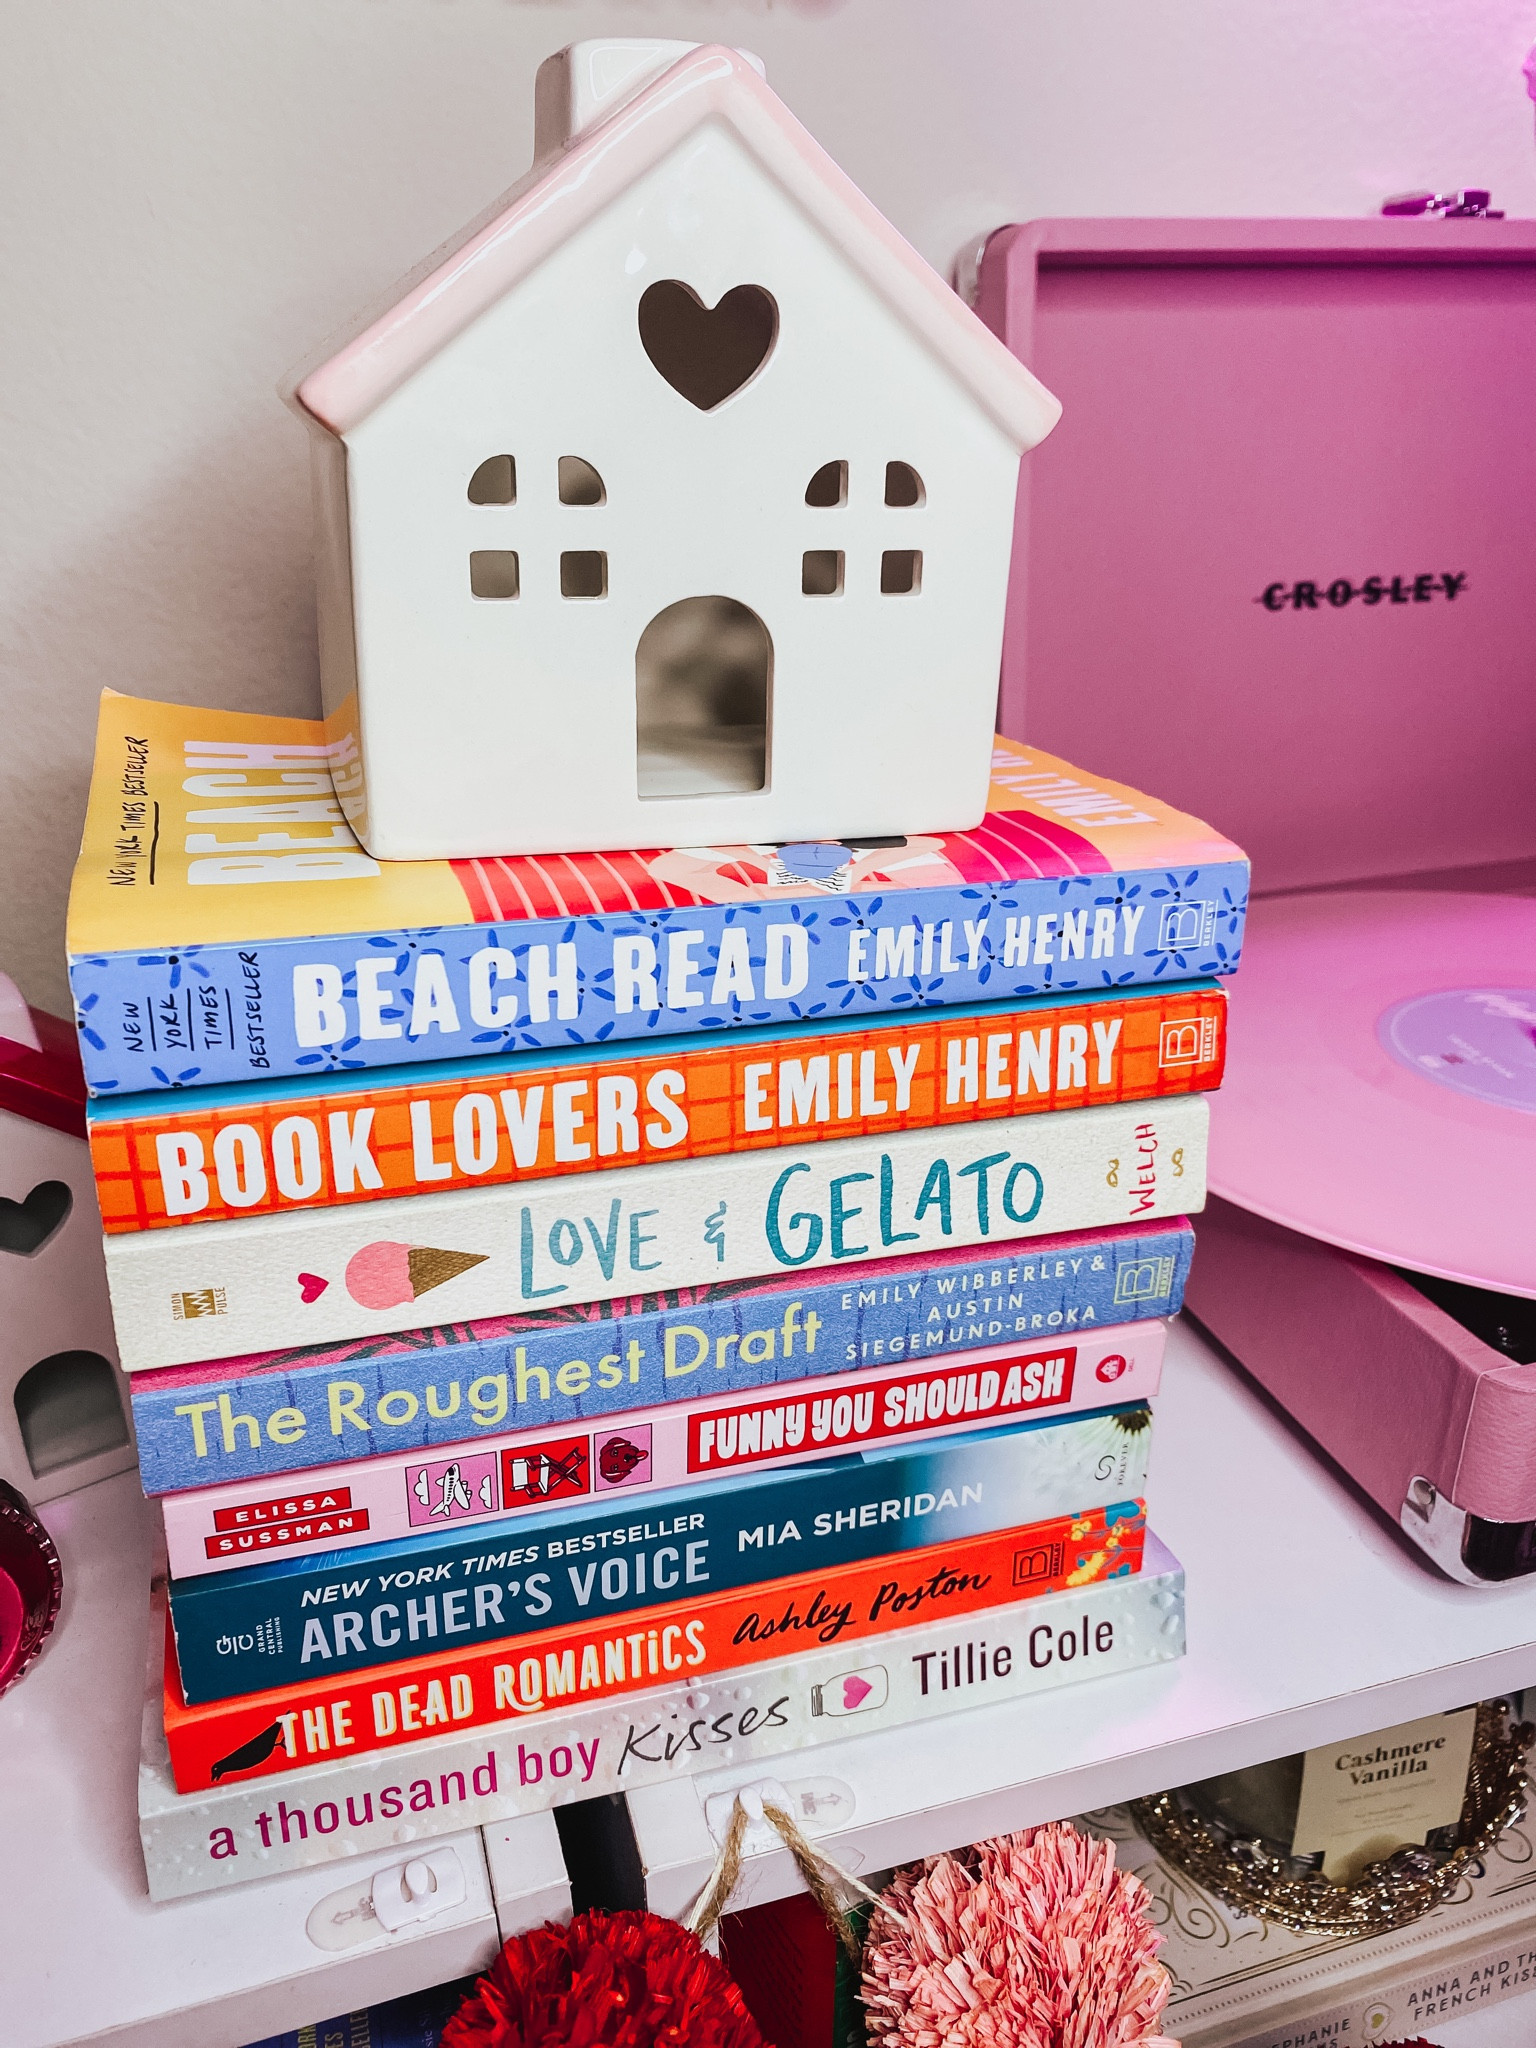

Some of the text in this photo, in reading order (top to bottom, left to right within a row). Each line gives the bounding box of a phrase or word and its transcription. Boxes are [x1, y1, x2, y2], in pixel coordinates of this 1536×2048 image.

[1252, 571, 1469, 612] CROSLEY
[120, 736, 149, 796] BESTSELLER
[120, 801, 146, 831] TIMES
[847, 905, 1146, 982] EMILY HENRY
[1202, 900, 1215, 947] BERKLEY
[238, 951, 269, 1069] BESTSELLER
[292, 923, 809, 1049] BEACH READ
[122, 1002, 145, 1052] NEW
[159, 993, 187, 1049] YORK
[198, 985, 220, 1050] TIMES
[1202, 1016, 1214, 1062] BERKLEY
[743, 1019, 1123, 1132] EMILY HENRY
[155, 1069, 689, 1216] BOOK LOVERS
[1128, 1123, 1159, 1216] WELCH
[520, 1151, 1044, 1299] LOVE & GELATO
[170, 1292, 184, 1321] SIMON
[213, 1286, 229, 1315] PULSE
[841, 1255, 1106, 1311] EMILY WIBBERLEY &
[926, 1292, 1024, 1323] AUSTIN
[845, 1305, 1096, 1361] SIEGEMUND-BROKA
[174, 1303, 822, 1458] The Roughest Draft
[699, 1402, 806, 1463] FUNNY
[883, 1370, 1000, 1428] SHOULD
[999, 1357, 1067, 1407] ASK
[219, 1517, 353, 1551] SUSSMAN
[235, 1496, 337, 1523] ELISSA
[737, 1482, 983, 1552] MIA SHERIDAN
[300, 1513, 706, 1608] NEW YORK TIMES BESTSELLER
[568, 1540, 711, 1607] VOICE
[868, 1566, 992, 1622] Poston
[255, 1624, 266, 1653] GRAND
[265, 1618, 276, 1655] CENTRAL
[912, 1614, 1115, 1696] Tillie Cole
[276, 1699, 356, 1758] THE
[371, 1674, 473, 1737] DEAD
[1335, 1736, 1446, 1771] Cashmere
[1350, 1758, 1429, 1785] Vanilla
[208, 1826, 238, 1860] a
[255, 1751, 499, 1848] thousand
[518, 1738, 601, 1786] boy
[1407, 1977, 1461, 2006] ANNA
[1469, 1960, 1510, 1984] AND
[1413, 1983, 1491, 2021] FRENCH
